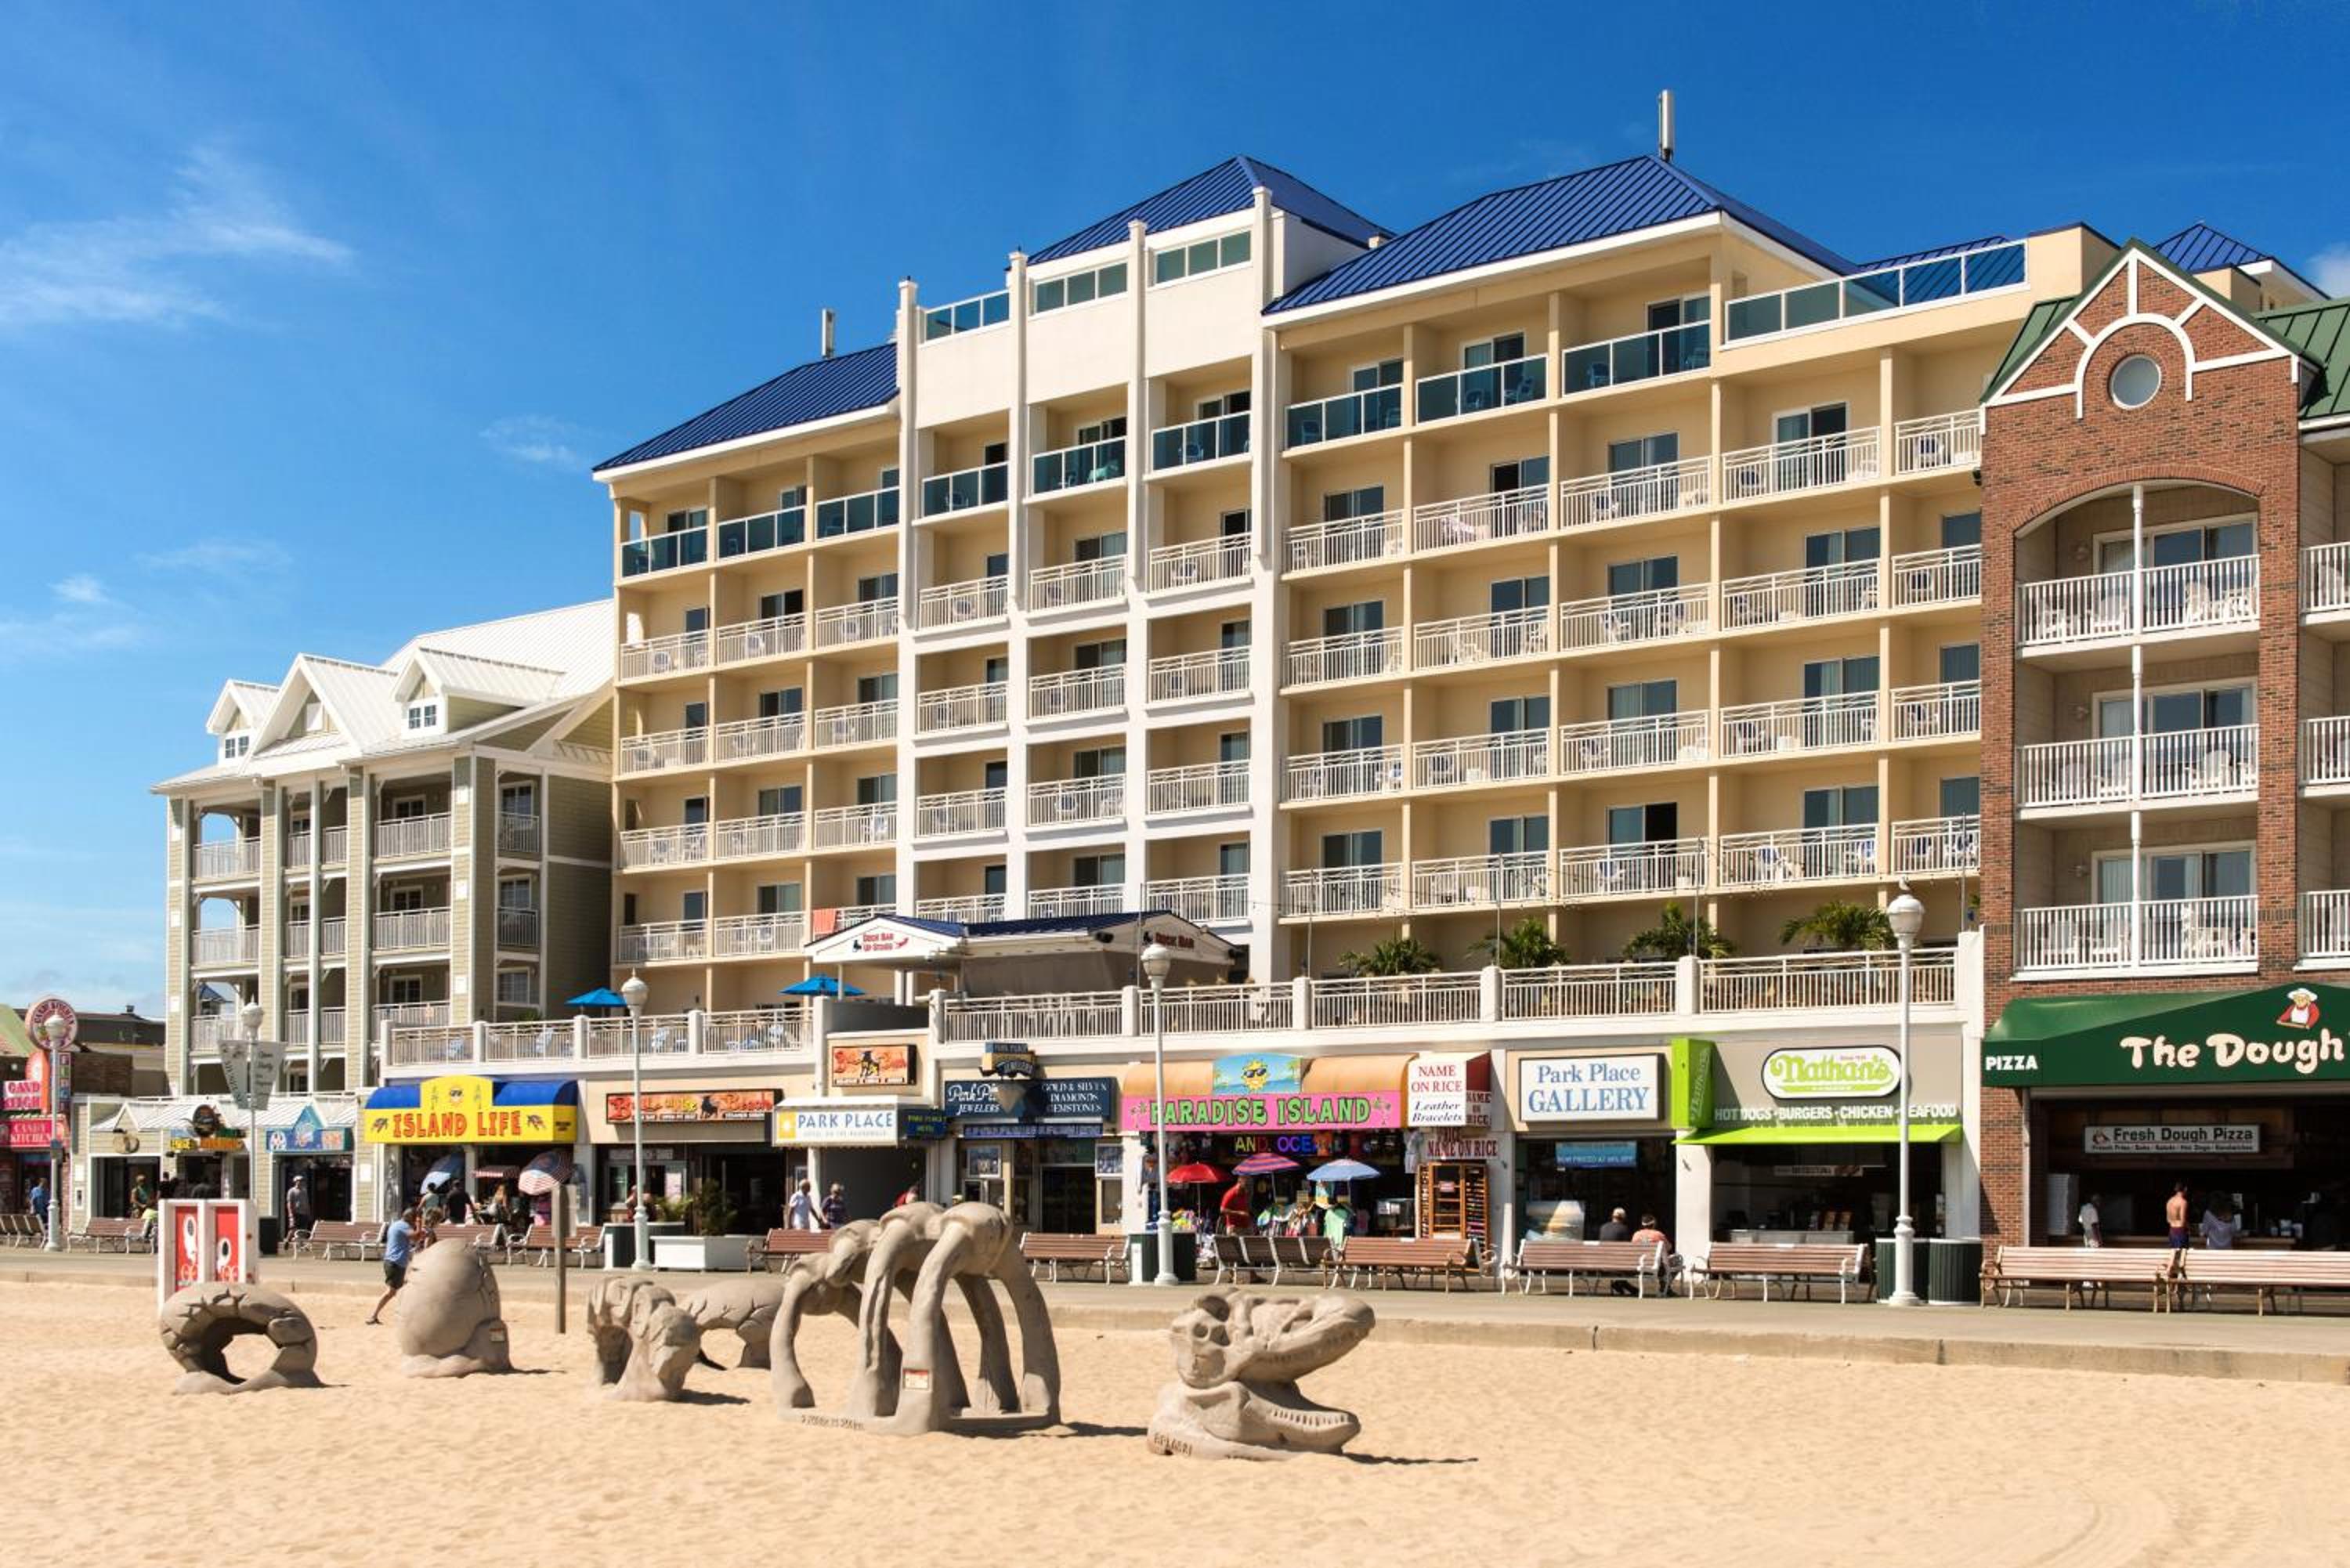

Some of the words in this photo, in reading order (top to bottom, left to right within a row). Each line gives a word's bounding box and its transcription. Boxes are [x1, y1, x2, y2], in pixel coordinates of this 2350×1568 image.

[2120, 1035, 2200, 1068] The
[2206, 1028, 2345, 1074] Dough
[1419, 1065, 1455, 1077] NAME
[1770, 1053, 1893, 1082] Nathan's
[1986, 1054, 2038, 1071] PIZZA
[1538, 1064, 1582, 1083] Park
[1590, 1063, 1640, 1082] Place
[1412, 1082, 1430, 1093] ON
[1433, 1081, 1462, 1092] RICE
[1415, 1100, 1460, 1111] Leather
[1528, 1087, 1650, 1112] GALLERY
[1278, 1097, 1371, 1125] ISLAND
[1412, 1111, 1462, 1122] Bracelets
[1714, 1108, 1737, 1121] HOT
[1740, 1107, 1772, 1120] DOGS
[1779, 1106, 1832, 1119] BURGERS
[1840, 1105, 1893, 1118] CHICKEN
[1907, 1104, 1957, 1118] EAFOOD
[392, 1111, 468, 1138] ISLAND
[478, 1111, 521, 1136] LIFE
[798, 1114, 835, 1128] PARK
[845, 1112, 893, 1128] PLACE
[2113, 1128, 2155, 1141] Fresh
[2161, 1128, 2207, 1143] Dough
[2214, 1127, 2253, 1140] Pizza
[1427, 1141, 1456, 1157] NAME
[1459, 1141, 1472, 1156] ON
[1474, 1140, 1497, 1156] RICE
